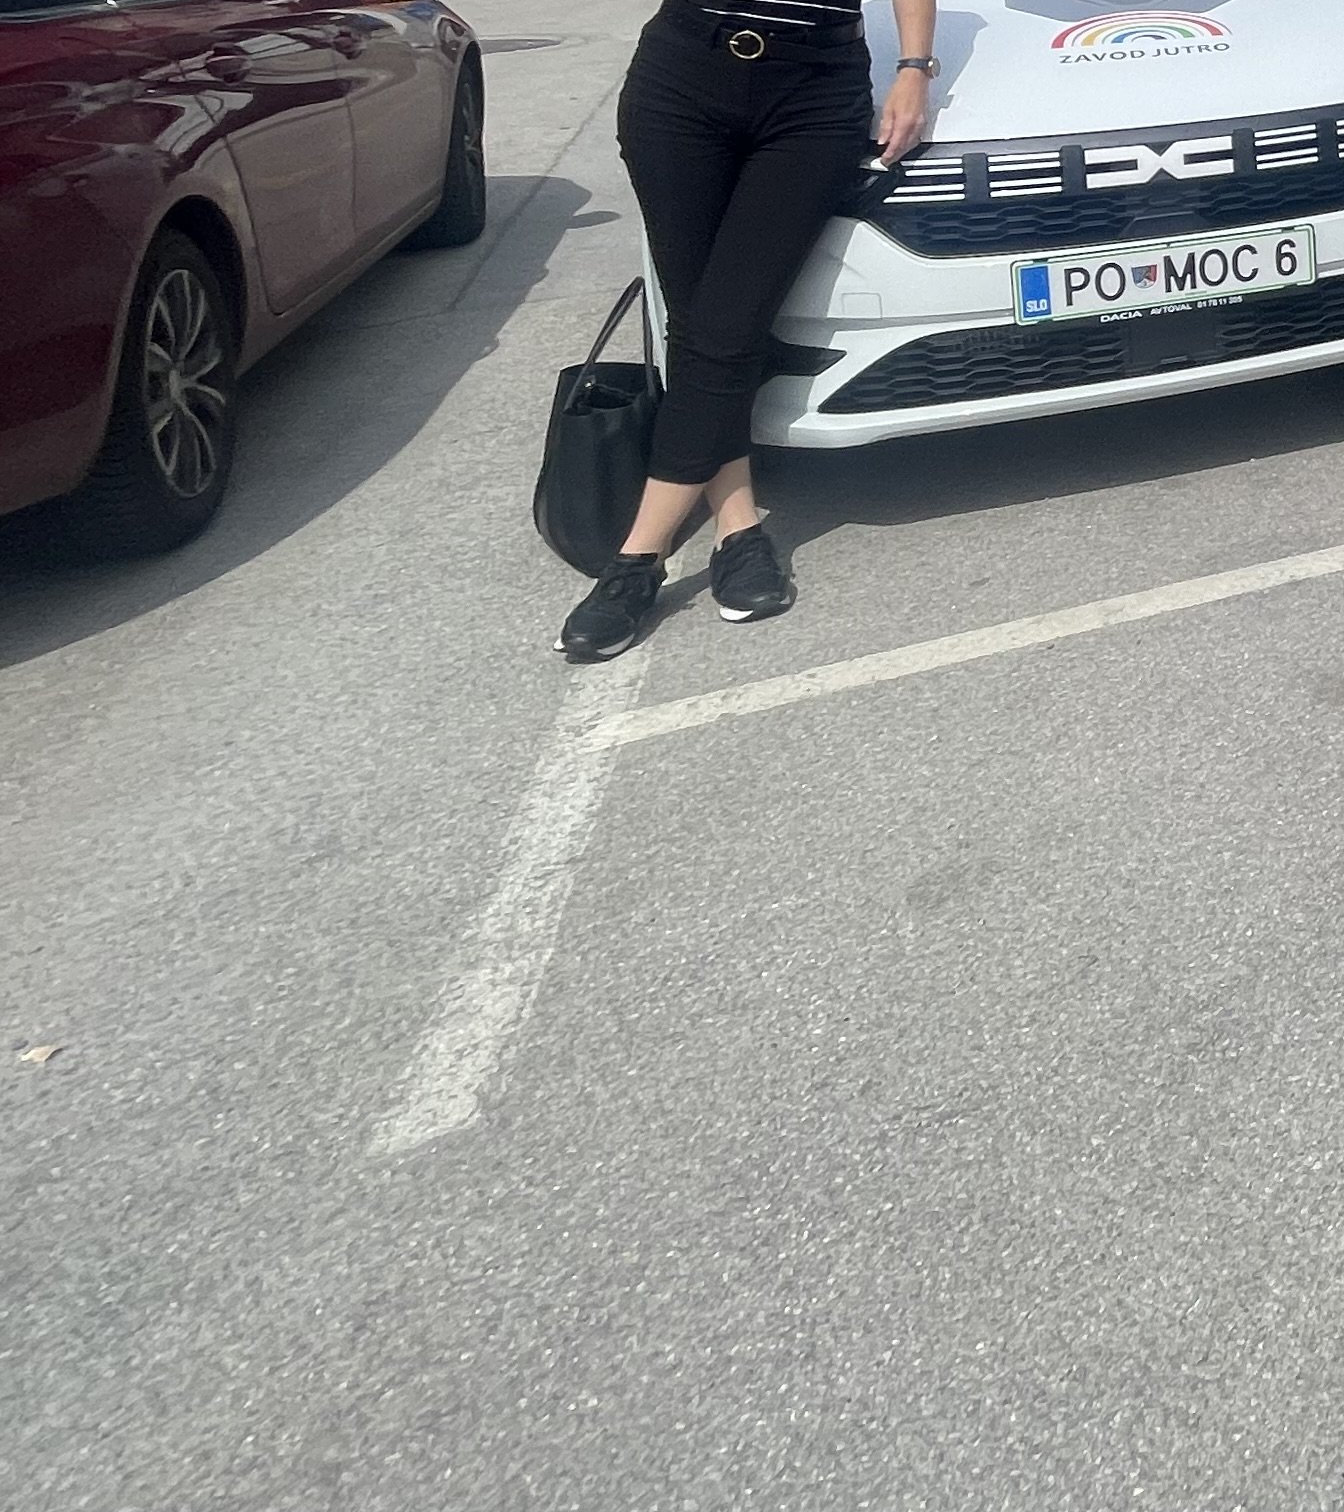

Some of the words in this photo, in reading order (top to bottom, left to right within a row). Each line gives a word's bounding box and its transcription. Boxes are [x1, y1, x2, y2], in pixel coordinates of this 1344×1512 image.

[1059, 50, 1145, 64] ZAVOD
[1152, 42, 1230, 58] JUTRO
[1064, 262, 1126, 307] PO
[1163, 244, 1259, 293] MOC
[1275, 238, 1297, 276] 6
[1026, 299, 1048, 313] SLO
[1100, 310, 1143, 323] DACIA
[1150, 303, 1193, 316] AVTOVAL
